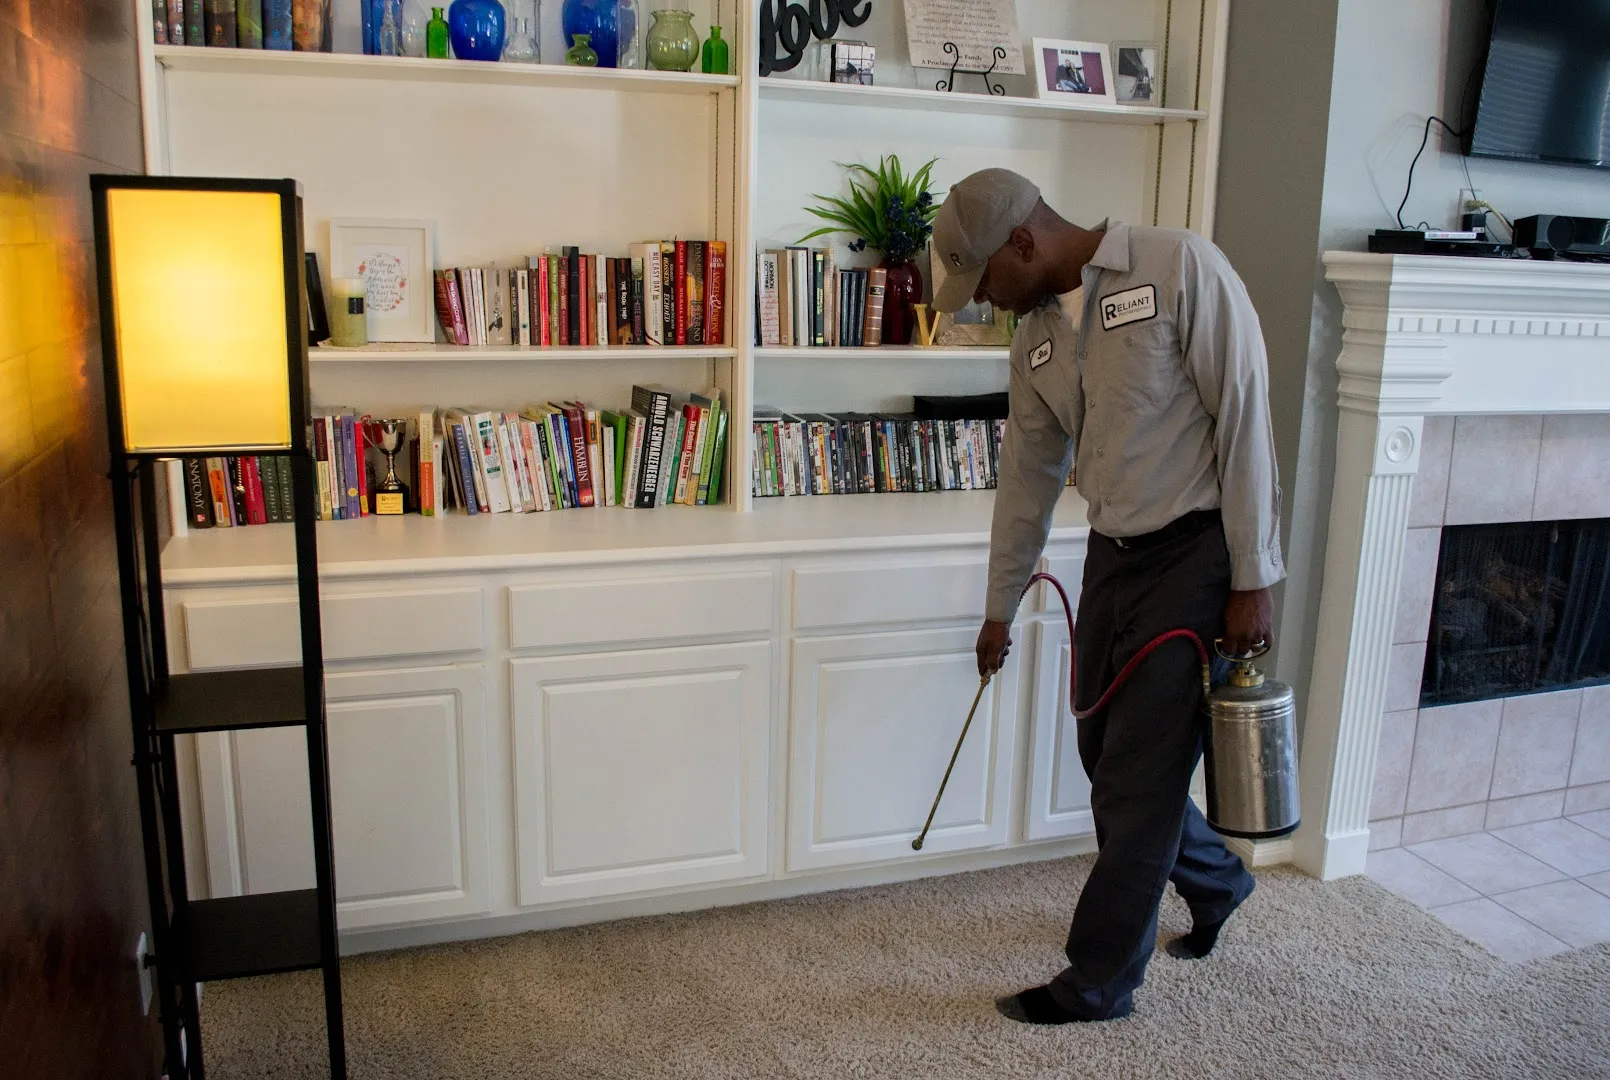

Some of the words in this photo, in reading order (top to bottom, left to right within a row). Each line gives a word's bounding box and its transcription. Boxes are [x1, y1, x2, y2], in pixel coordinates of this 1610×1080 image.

[964, 54, 982, 62] Family
[652, 252, 659, 260] NO
[694, 243, 702, 261] DAN
[712, 271, 720, 297] ANGELS
[709, 295, 721, 309] &
[1105, 297, 1150, 321] RELIANT
[692, 302, 703, 342] INFERNO
[712, 308, 720, 334] DEMONS
[654, 395, 668, 424] ARNOLD
[686, 431, 695, 450] Culprit
[574, 436, 588, 482] HAMBLIN
[644, 426, 663, 493] SCHWARZENEGGER
[190, 459, 205, 509] ANATOMY
